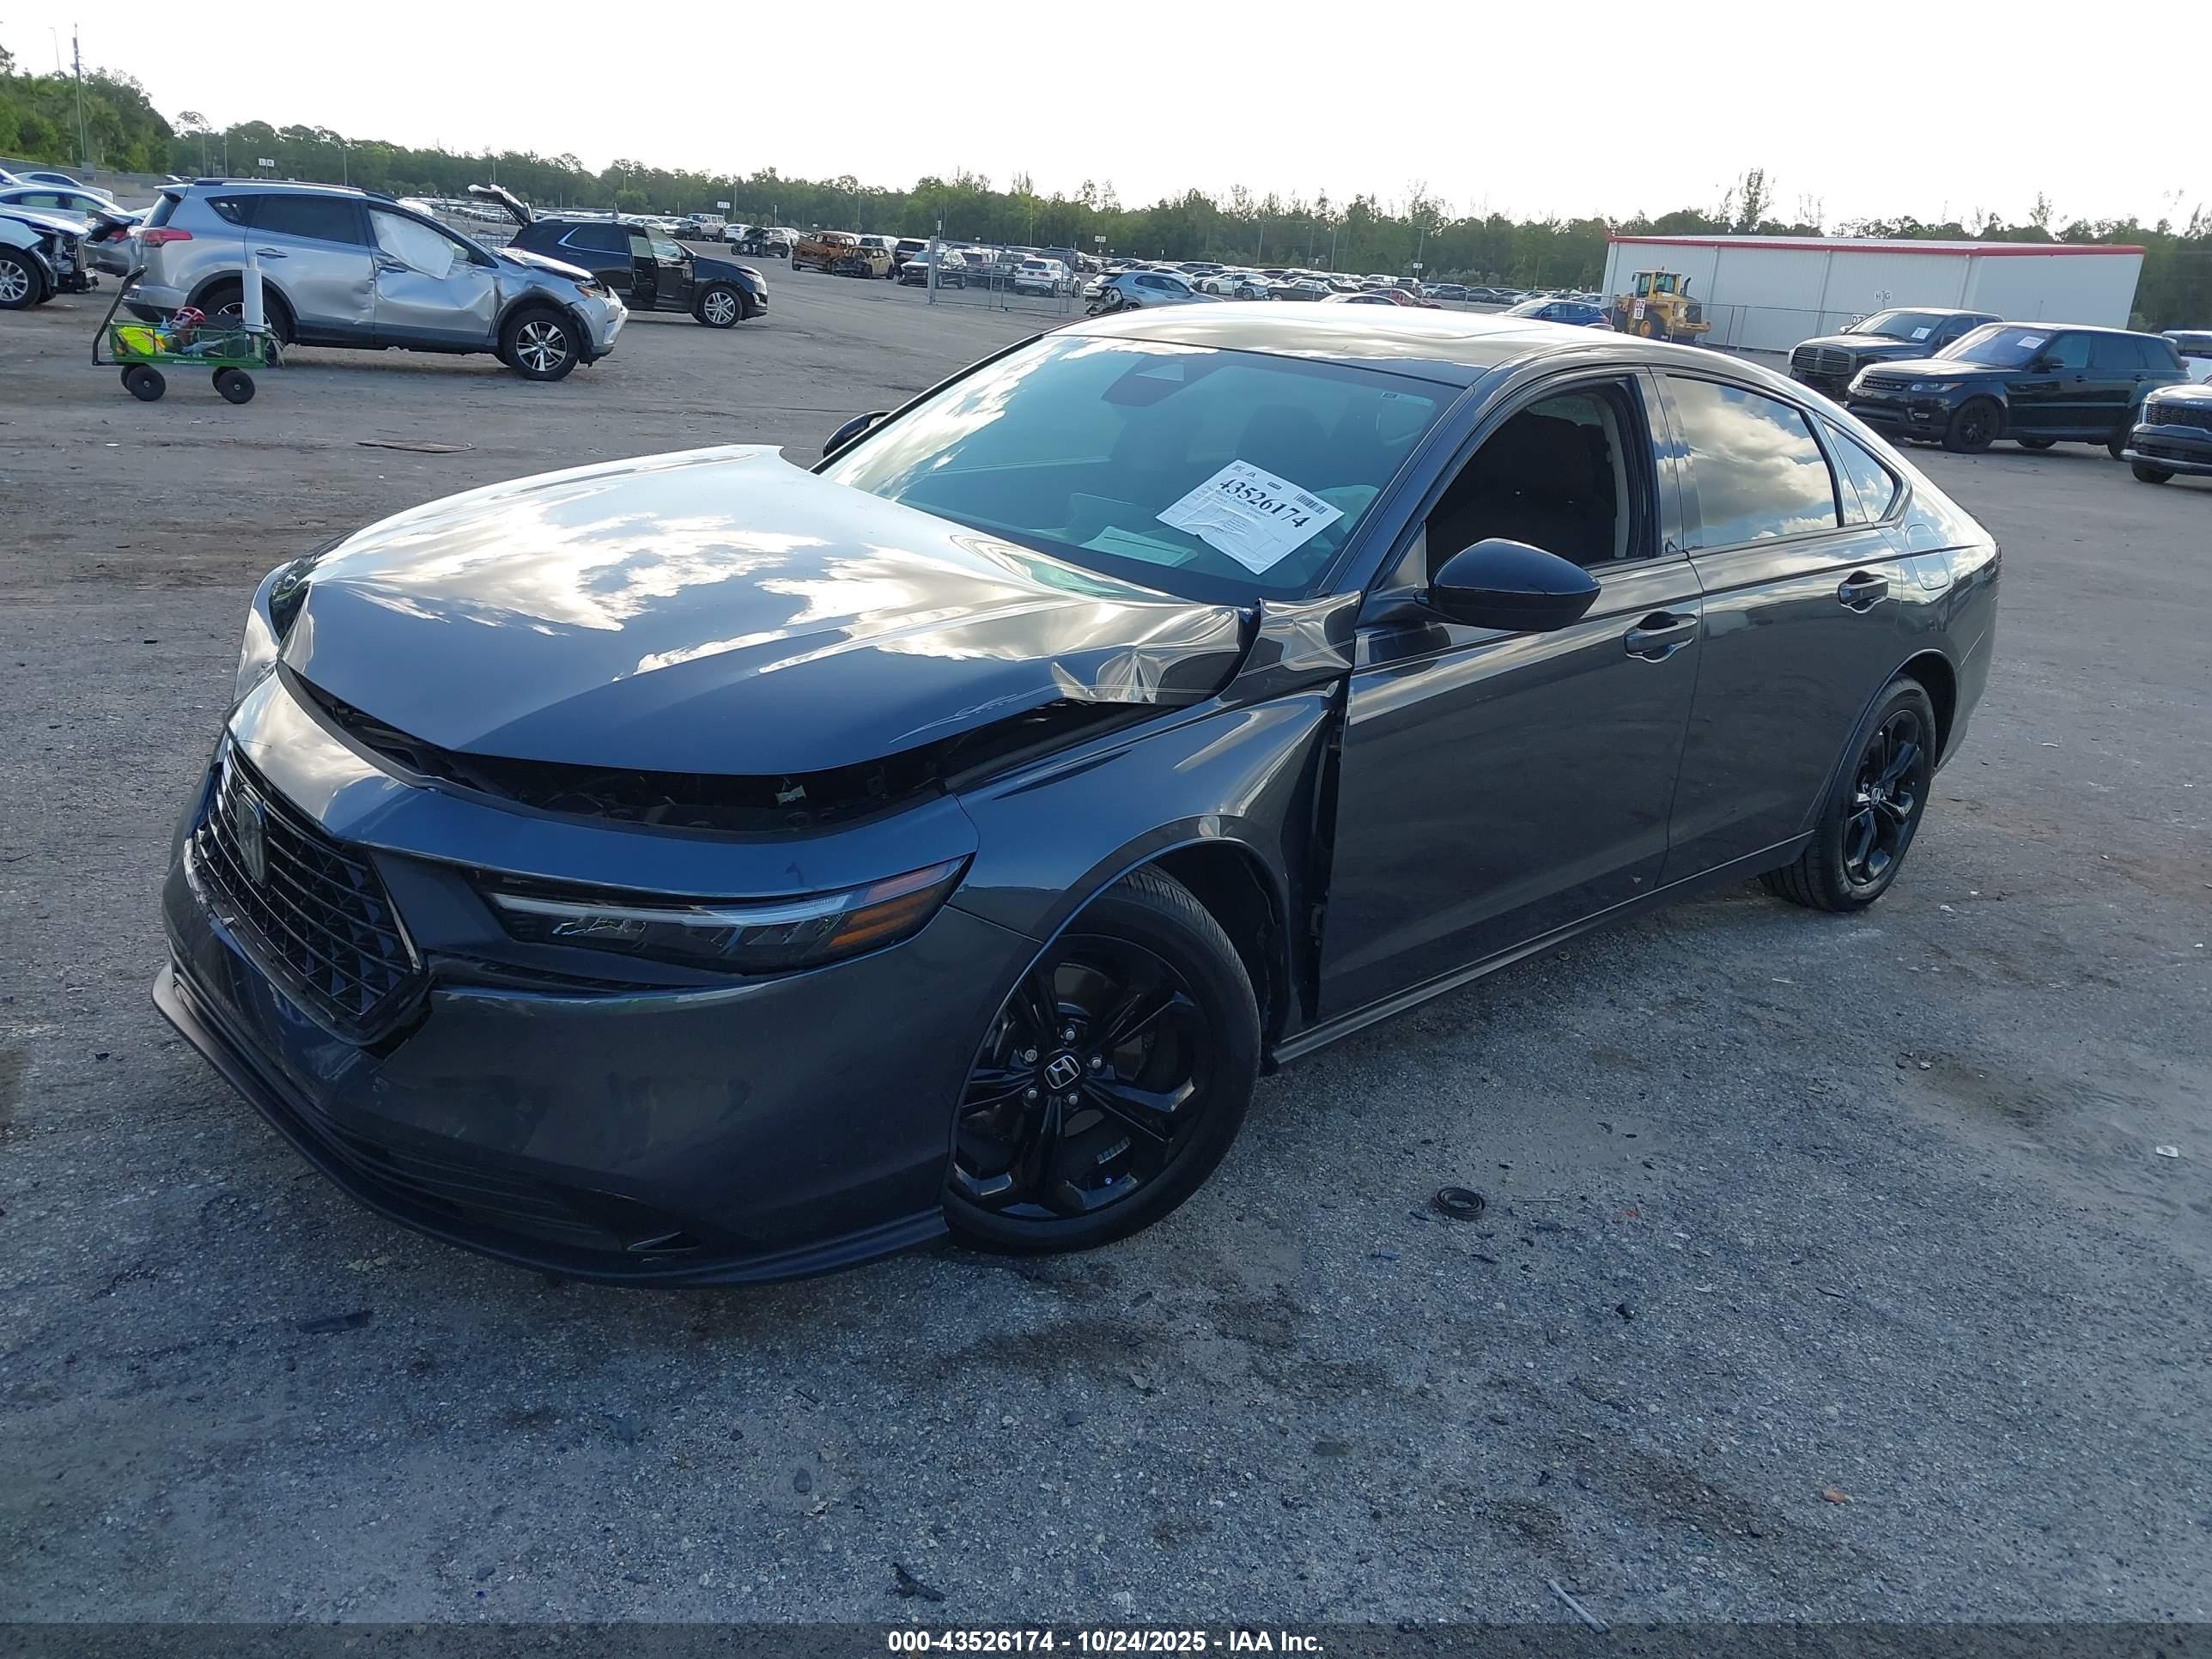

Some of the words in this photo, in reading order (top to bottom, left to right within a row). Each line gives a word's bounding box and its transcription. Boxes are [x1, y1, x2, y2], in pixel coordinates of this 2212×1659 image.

[1875, 292, 1881, 301] H
[1885, 292, 1891, 301] G
[1635, 301, 1644, 310] DZ
[1635, 309, 1643, 318] 13
[1219, 478, 1311, 528] 43526174
